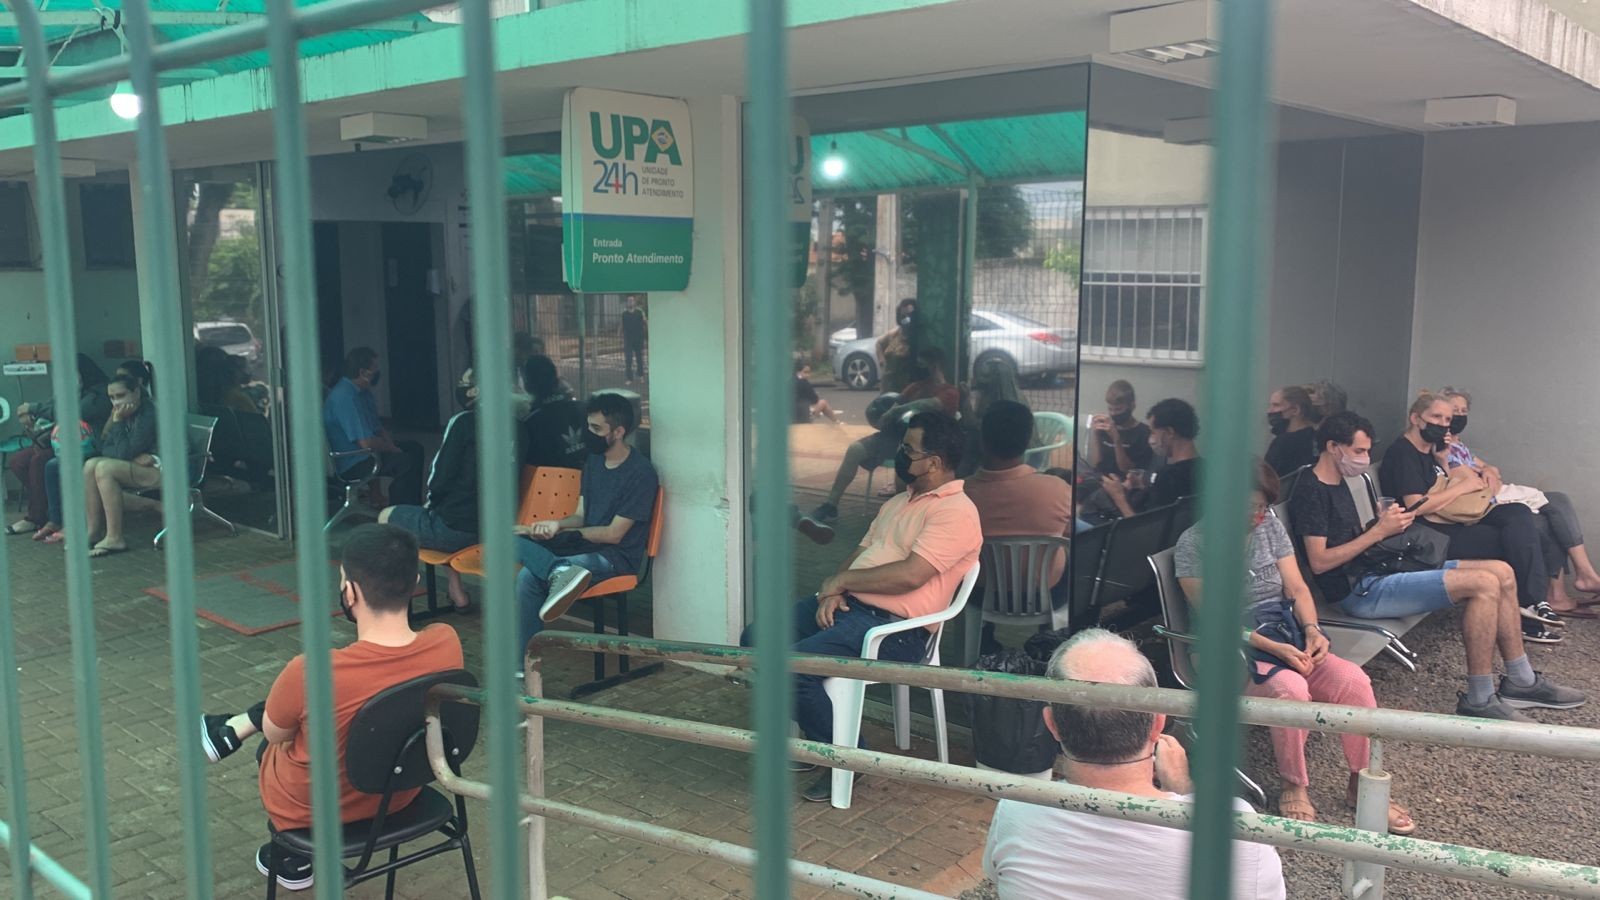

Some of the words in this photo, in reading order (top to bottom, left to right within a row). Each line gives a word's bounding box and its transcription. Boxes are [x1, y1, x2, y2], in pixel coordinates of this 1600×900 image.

[590, 111, 682, 166] UPA
[641, 166, 668, 175] UNIDADE
[593, 160, 638, 195] 24h
[641, 177, 649, 185] DE
[651, 178, 675, 186] PRONTO
[641, 188, 684, 198] ATENDIMENTO
[593, 238, 622, 248] Entrada
[592, 253, 624, 263] Pronto
[626, 253, 684, 264] Atendimento
